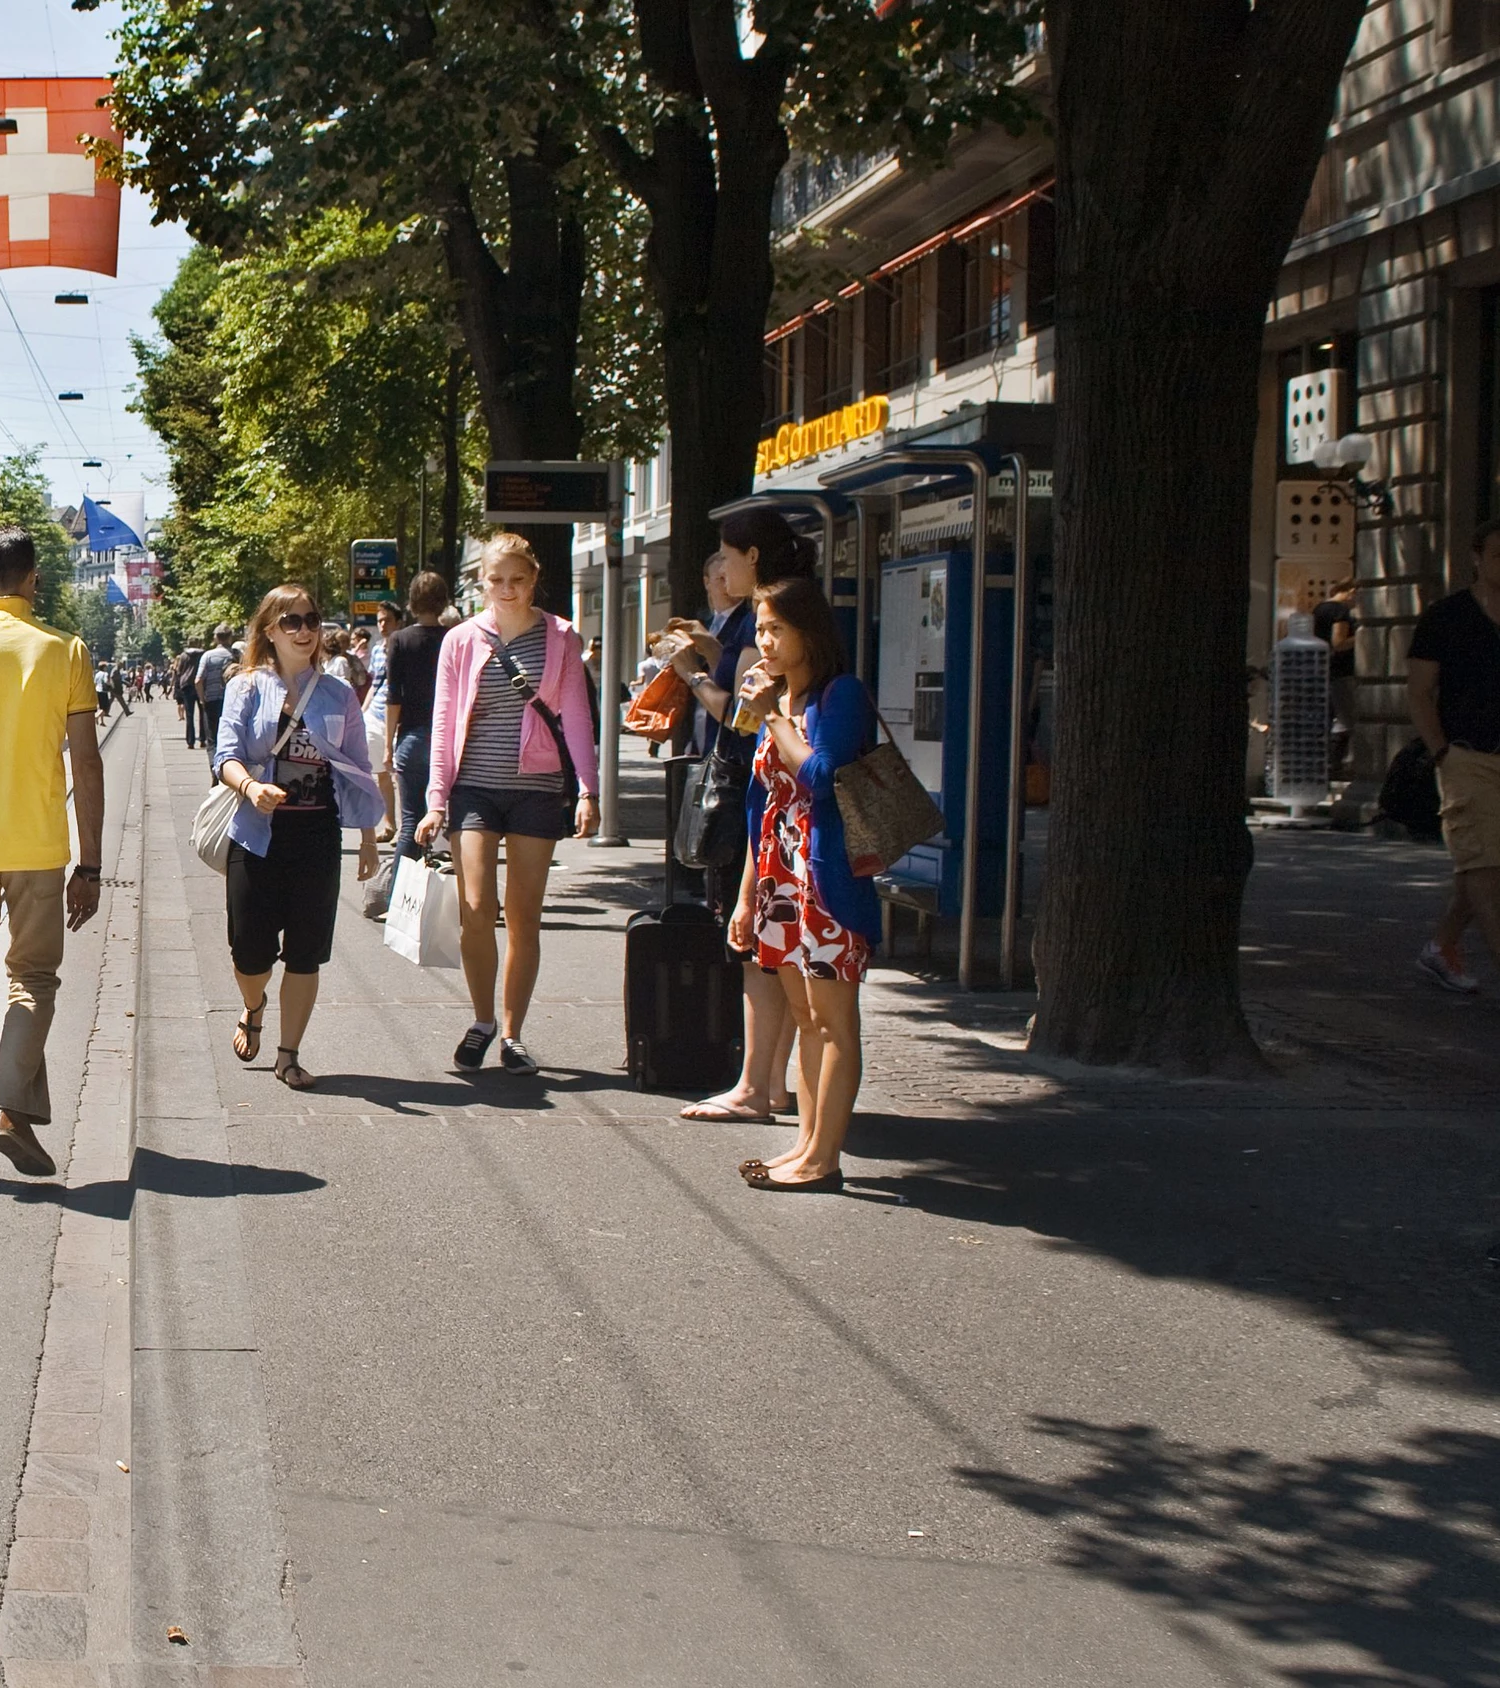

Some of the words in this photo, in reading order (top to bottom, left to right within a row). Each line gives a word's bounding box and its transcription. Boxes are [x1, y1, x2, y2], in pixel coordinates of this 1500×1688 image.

[775, 396, 888, 466] GOTTHARD
[1291, 533, 1339, 544] SIX
[358, 568, 365, 576] 6
[370, 568, 376, 576] 7
[380, 568, 387, 576] 11
[357, 604, 366, 612] 13
